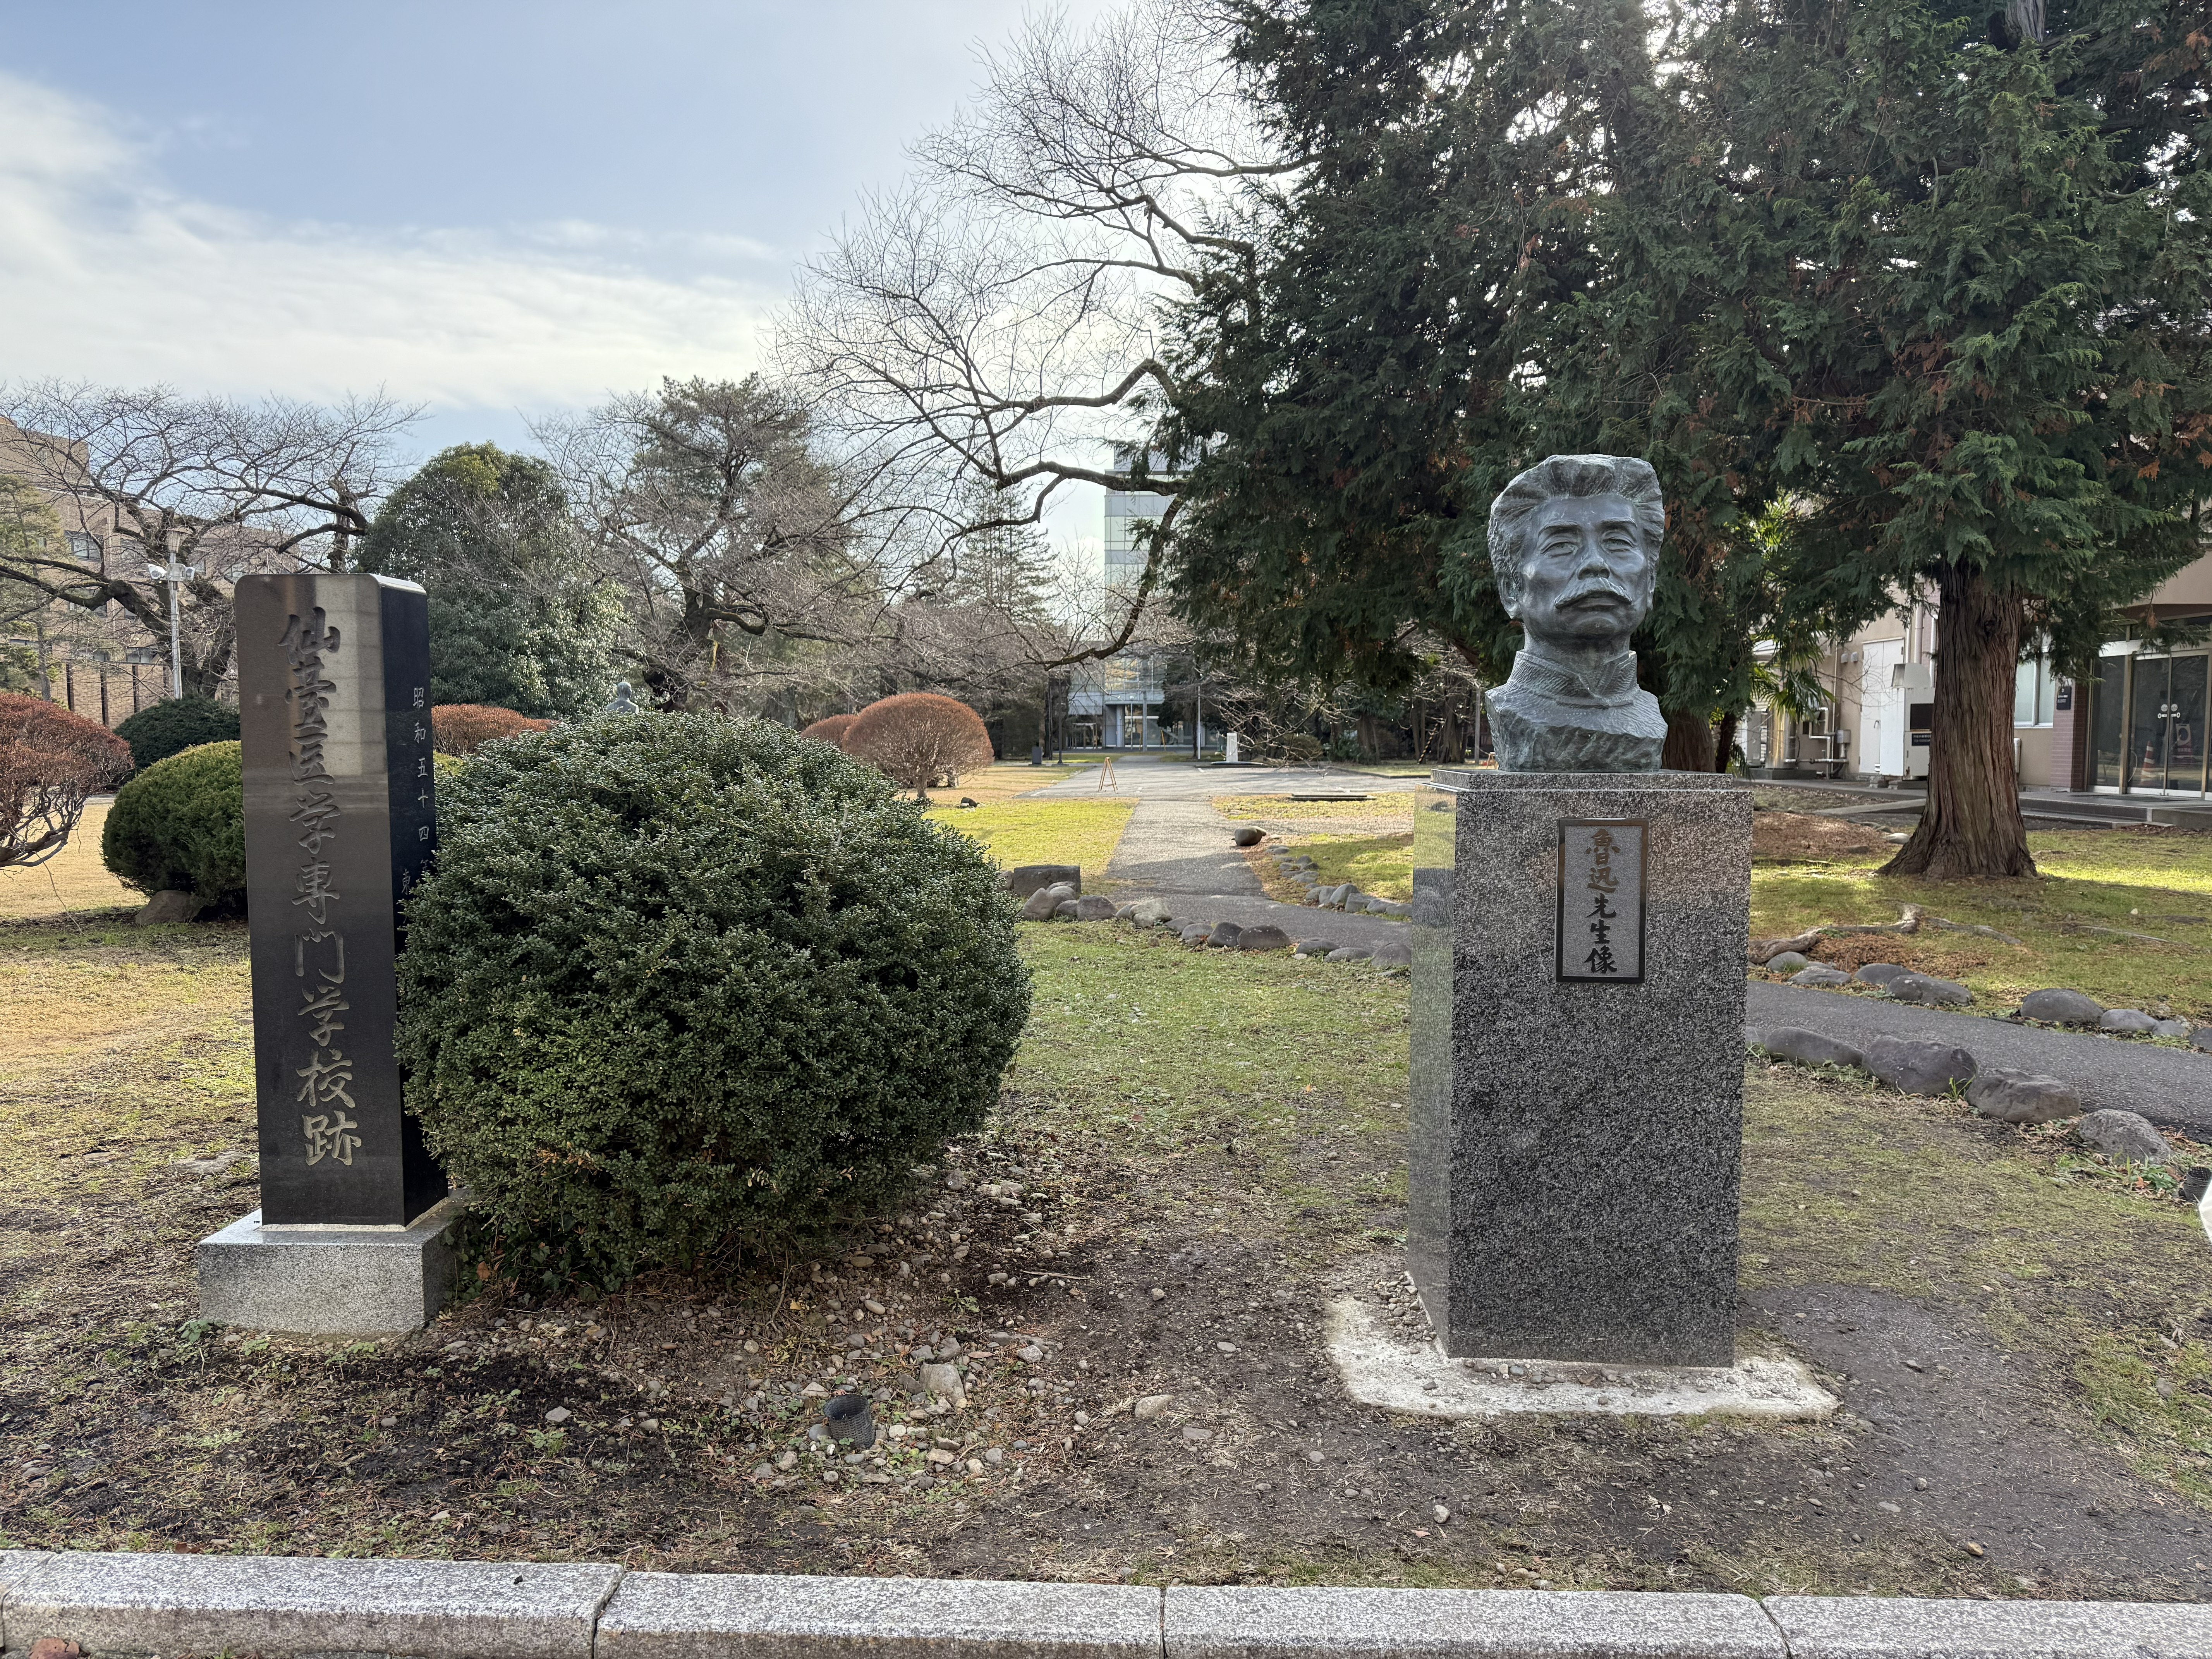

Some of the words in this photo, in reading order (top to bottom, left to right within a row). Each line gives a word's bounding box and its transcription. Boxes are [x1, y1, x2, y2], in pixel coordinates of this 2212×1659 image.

[1584, 828, 1620, 974] 魯迅先生像
